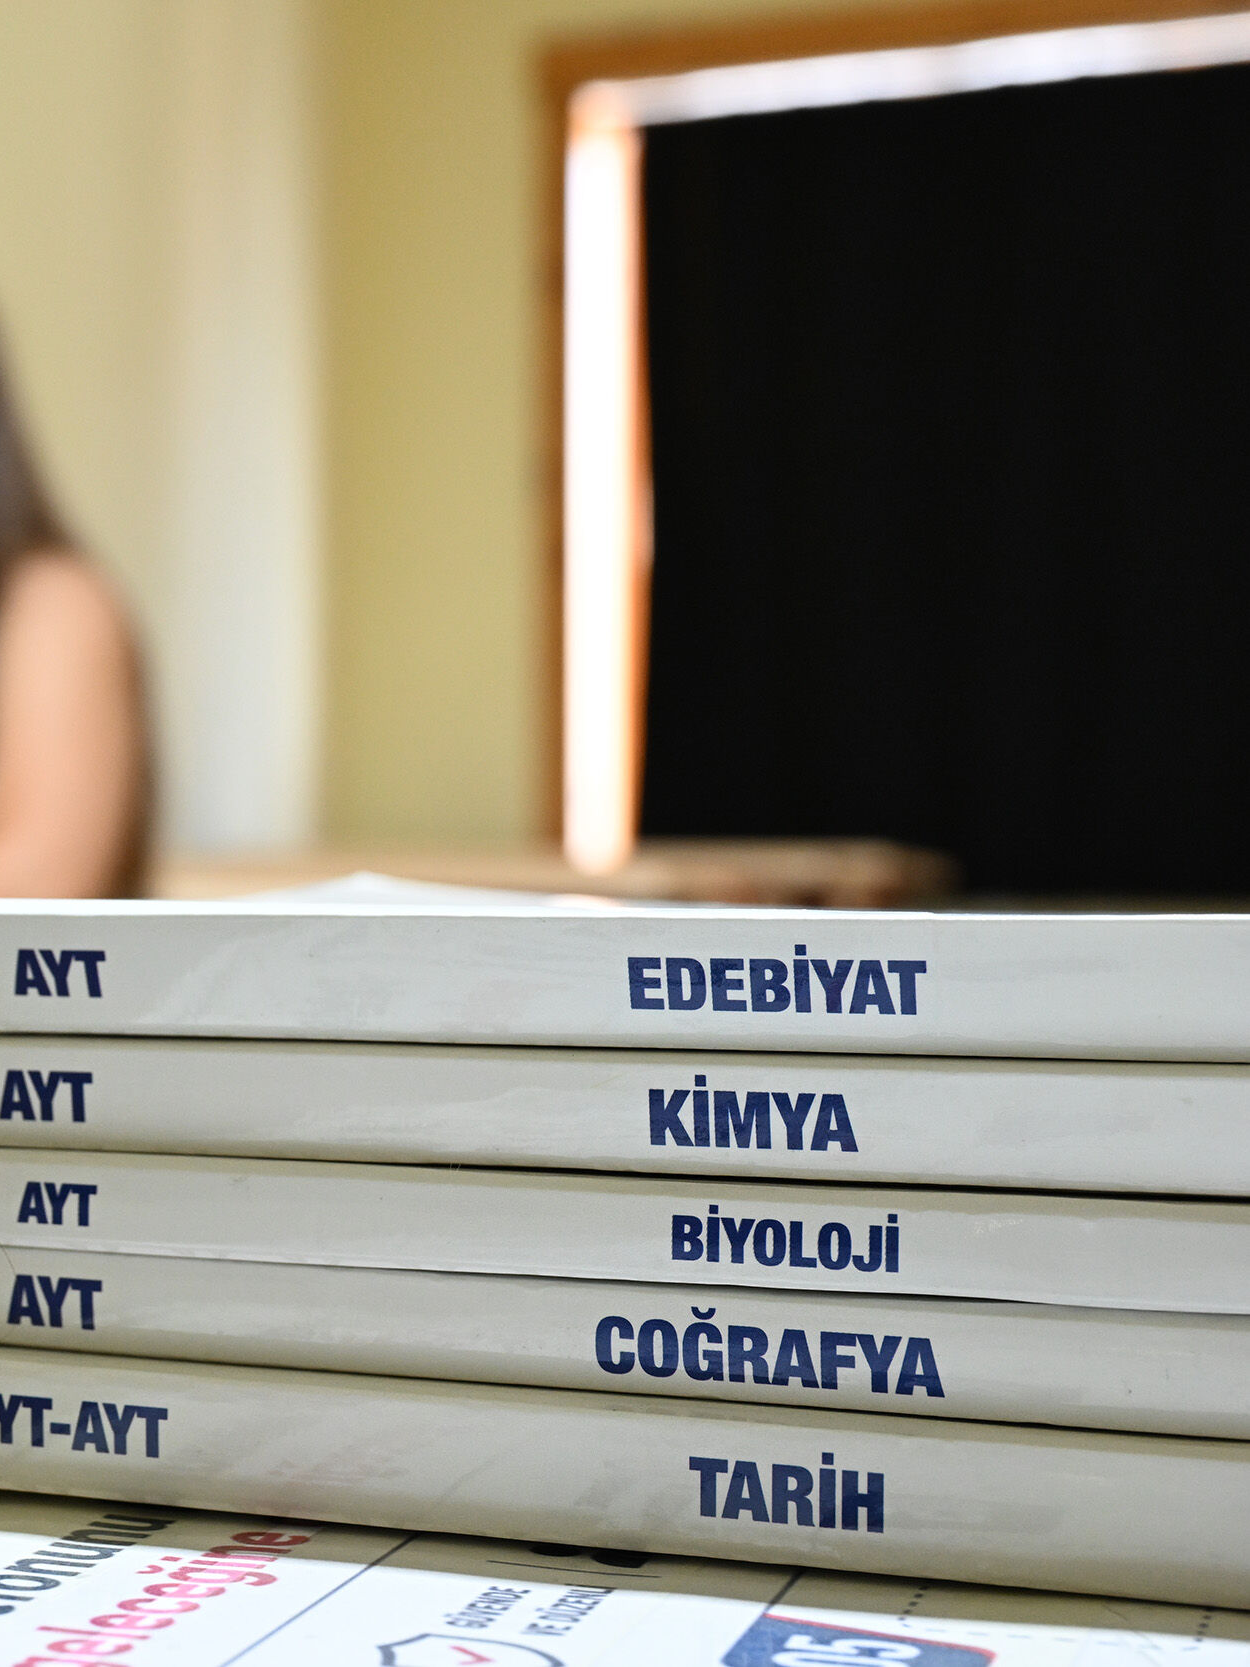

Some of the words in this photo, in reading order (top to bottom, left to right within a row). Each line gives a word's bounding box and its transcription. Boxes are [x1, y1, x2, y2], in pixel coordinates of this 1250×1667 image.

[14, 949, 106, 998] AYT
[627, 944, 927, 1016] EDEBİYAT
[648, 1075, 859, 1153] KİMYA
[17, 1181, 97, 1227] AYT
[671, 1205, 900, 1273] BİYOLOJİ
[7, 1274, 102, 1330] AYT
[594, 1306, 946, 1399] COĞRAFYA
[688, 1452, 885, 1534] TARİH
[444, 1585, 531, 1628] GÜVENDE
[520, 1621, 572, 1637] VE
